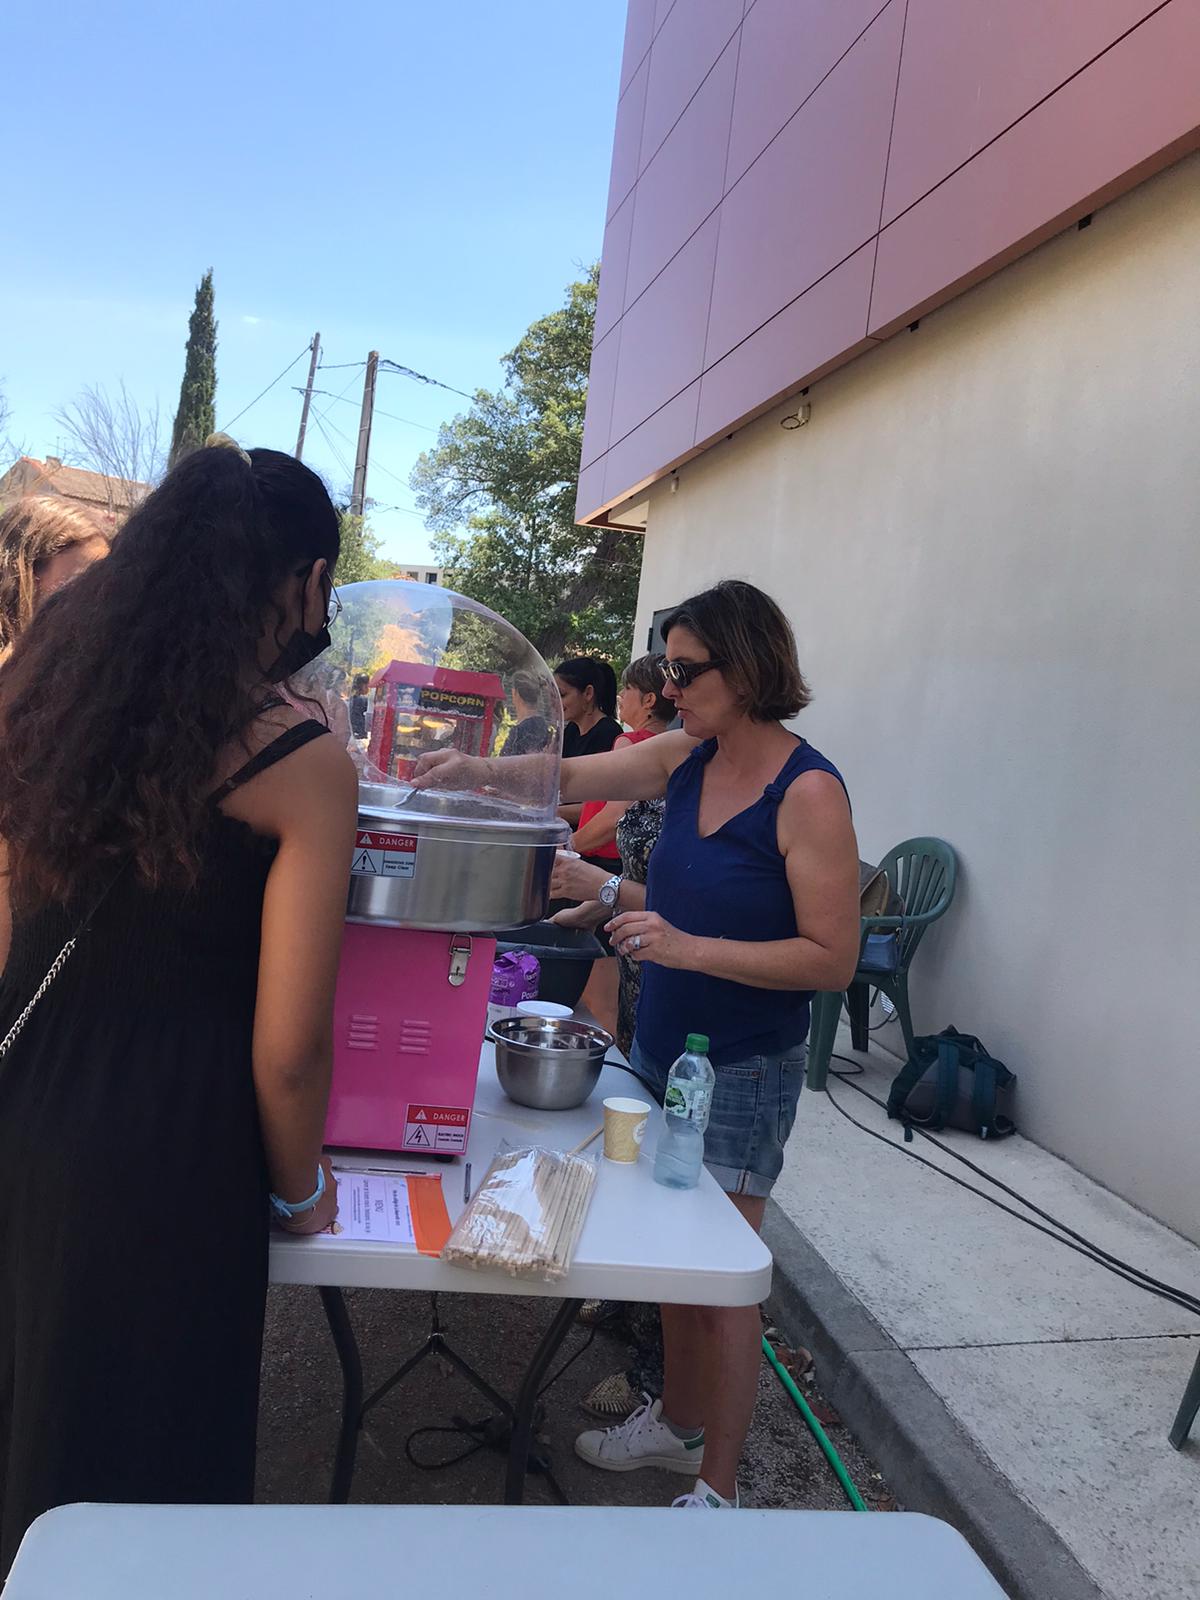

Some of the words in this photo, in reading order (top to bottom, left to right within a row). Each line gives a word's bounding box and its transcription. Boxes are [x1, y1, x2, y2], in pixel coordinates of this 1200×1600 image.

[421, 690, 485, 707] POPCORN
[379, 837, 415, 847] DANGER
[432, 1112, 466, 1122] DANGER
